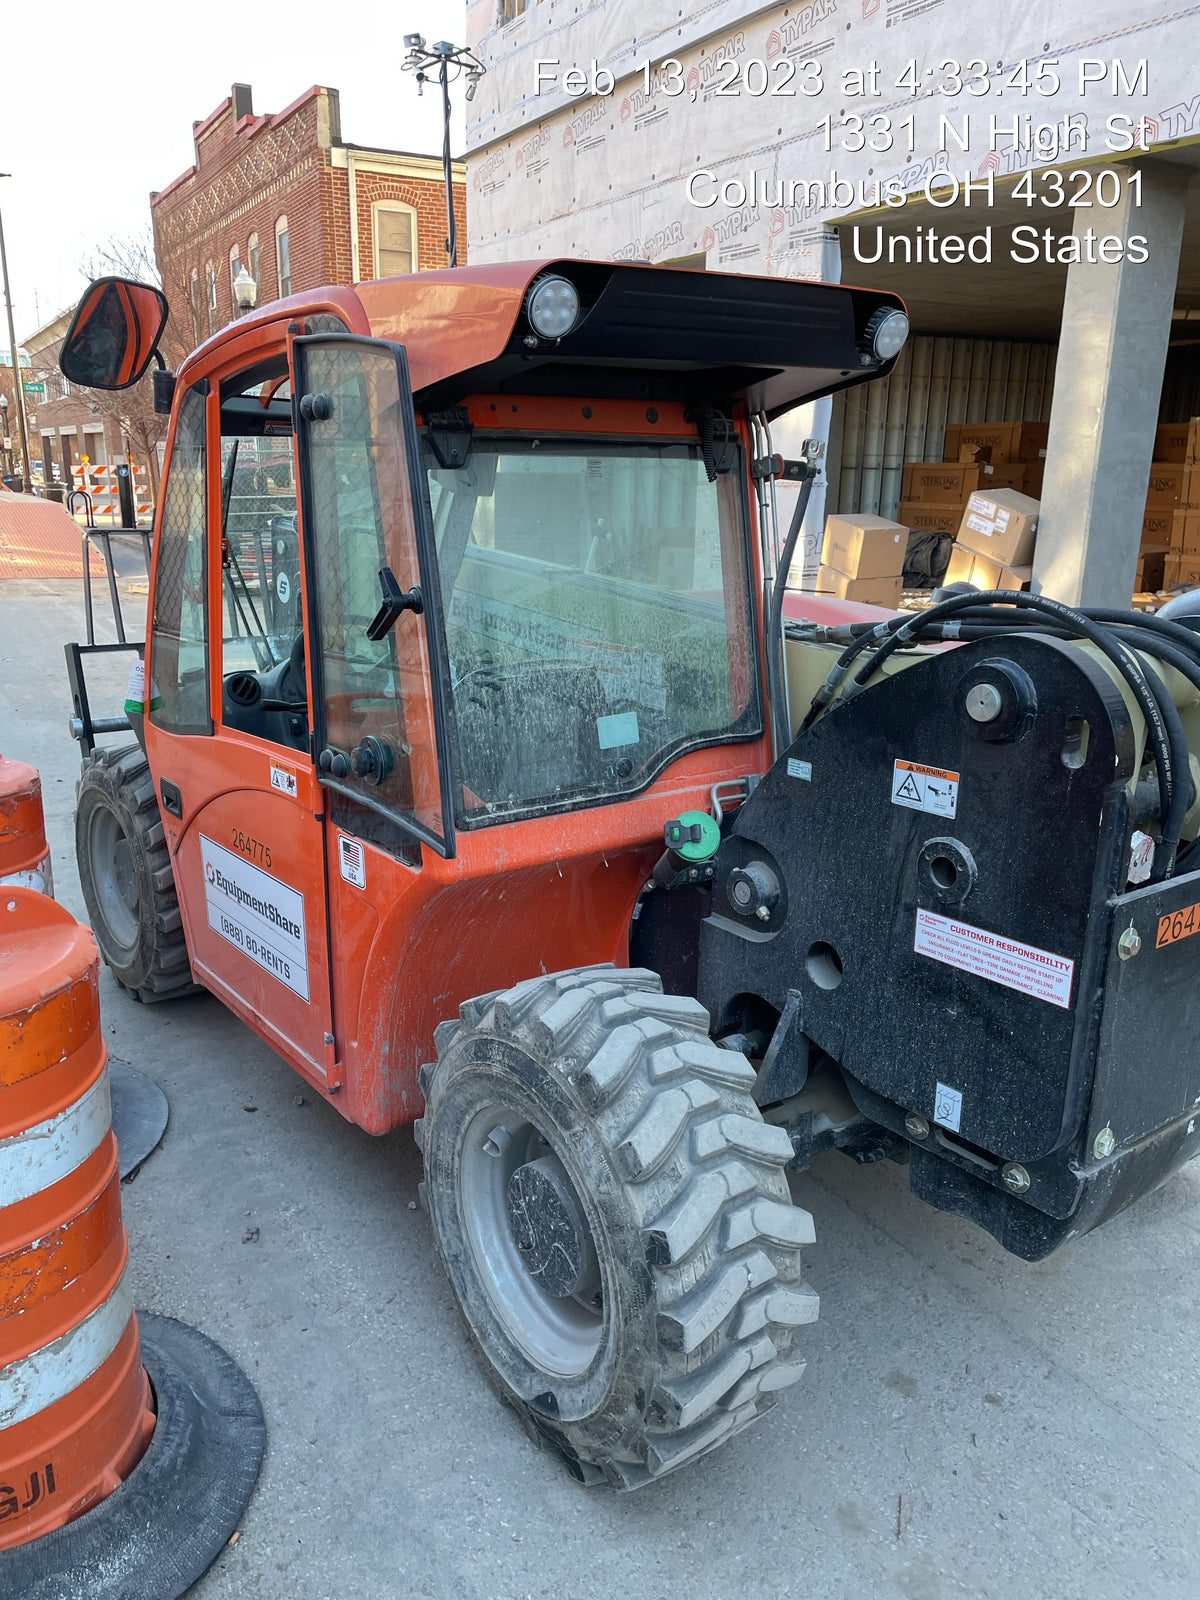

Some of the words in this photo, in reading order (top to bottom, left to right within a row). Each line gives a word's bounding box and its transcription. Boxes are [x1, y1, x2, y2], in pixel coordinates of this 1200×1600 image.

[1159, 95, 1200, 138] TY
[225, 443, 255, 451] NONAL
[920, 475, 960, 487] STERLING
[914, 515, 954, 528] STERLING
[915, 764, 948, 779] WARNING
[232, 827, 273, 868] 264775
[215, 868, 301, 940] EquipmentShare
[924, 914, 947, 925] Equipment
[1157, 904, 1200, 946] 264
[220, 915, 244, 946] (888)
[245, 935, 291, 980] 80-RENTS
[921, 928, 936, 938] CHECK
[945, 937, 960, 947] FLUID
[960, 943, 977, 953] LEVELS
[982, 951, 1001, 962] GREASE
[1001, 957, 1017, 967] DAILY
[1017, 962, 1037, 975] BEFORE
[1037, 969, 1055, 980] START
[928, 939, 955, 953] INSURANCE
[957, 949, 969, 958] FLAT
[969, 954, 984, 964] TIRES
[987, 960, 999, 969] TIRE
[999, 964, 1021, 978] DAMAGE
[1024, 974, 1054, 990] REFUELING
[950, 924, 995, 946] CUSTOMER
[995, 940, 1071, 972] RESPONSIBILITY
[917, 944, 937, 955] DAMAGE
[944, 953, 972, 969] EQUIPMENT
[974, 965, 996, 977] BATTERY
[996, 973, 1034, 991] MAINTENANCE
[1036, 988, 1064, 1003] CLEANING
